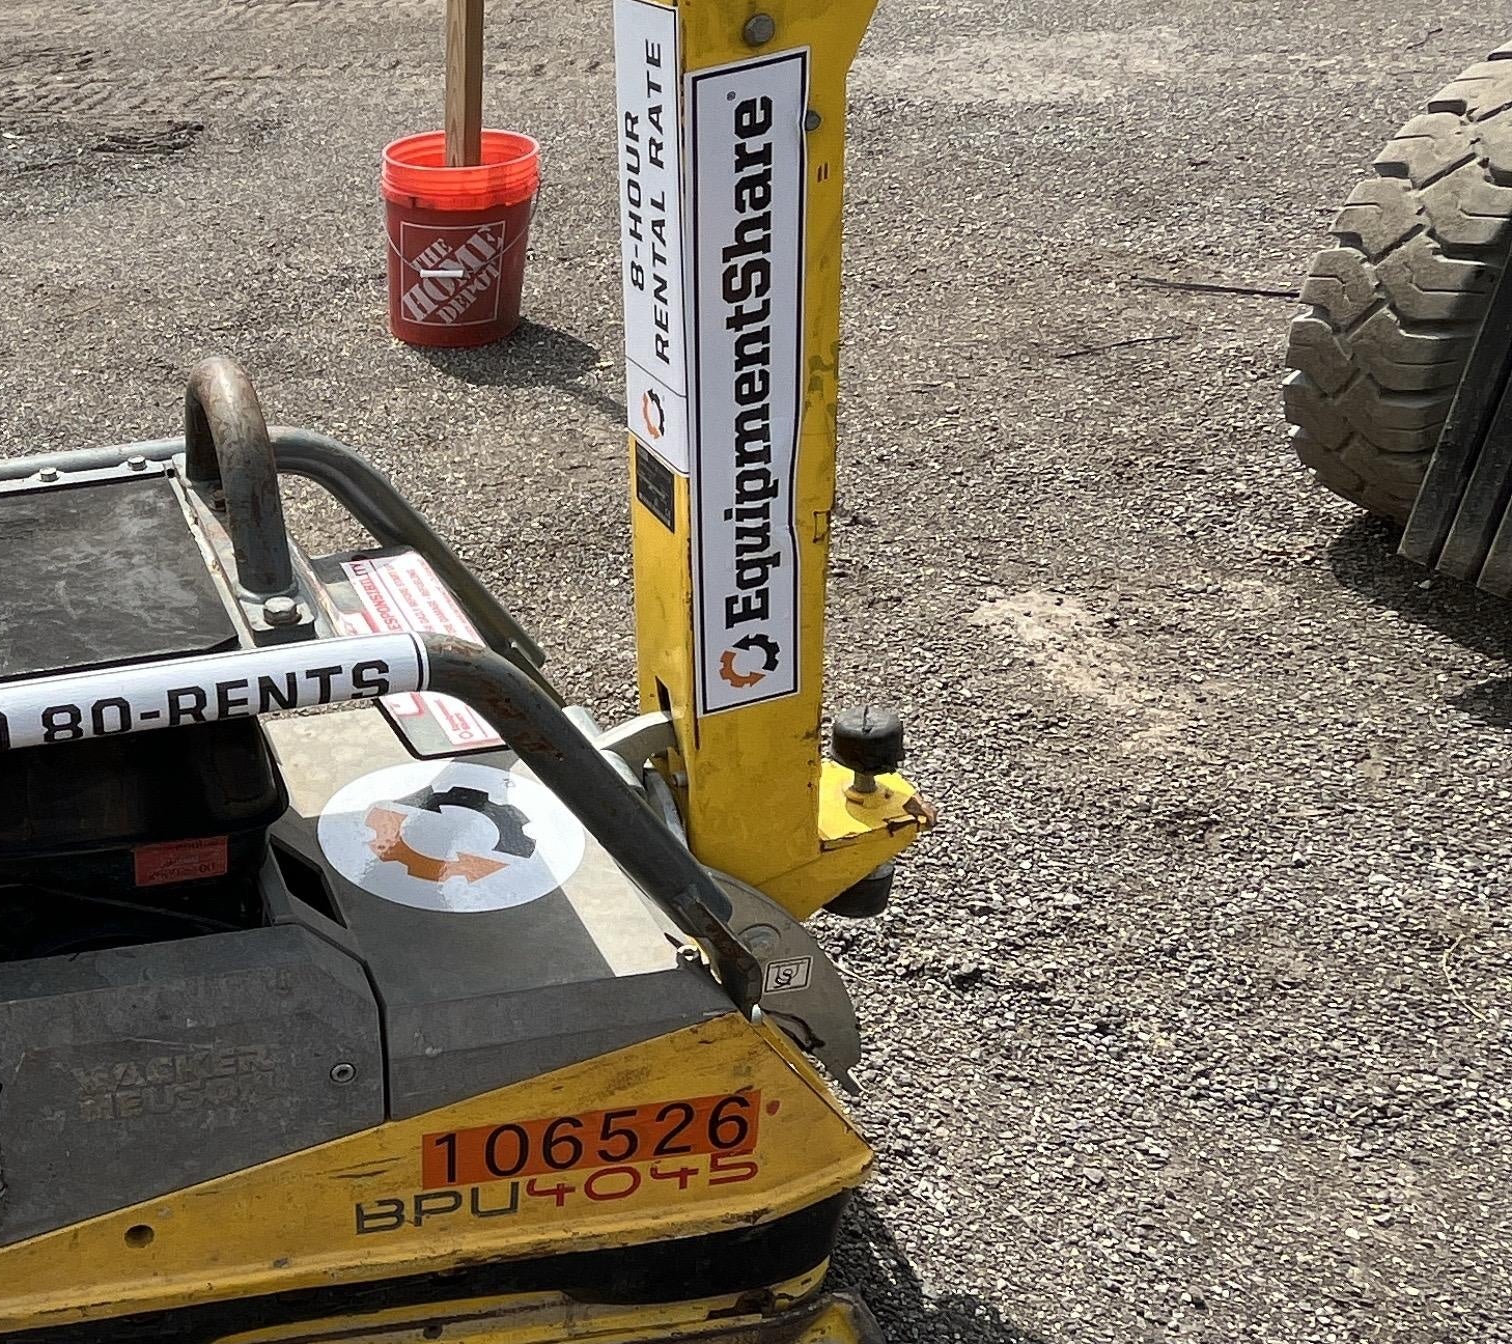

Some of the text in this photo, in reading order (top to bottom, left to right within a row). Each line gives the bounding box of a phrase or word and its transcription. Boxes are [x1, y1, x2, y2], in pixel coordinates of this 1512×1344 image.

[624, 110, 645, 292] 8-HOUR
[645, 37, 670, 365] RENTAL RATE
[402, 226, 503, 323] HOME
[410, 238, 454, 270] THE
[437, 259, 501, 325] DEPOT
[722, 93, 781, 630] EquipmentShare
[349, 561, 402, 633] ESPONSIBILITY
[41, 659, 391, 744] 80-RENTS
[434, 1095, 753, 1184] 106526
[355, 1148, 759, 1236] BPU4045
